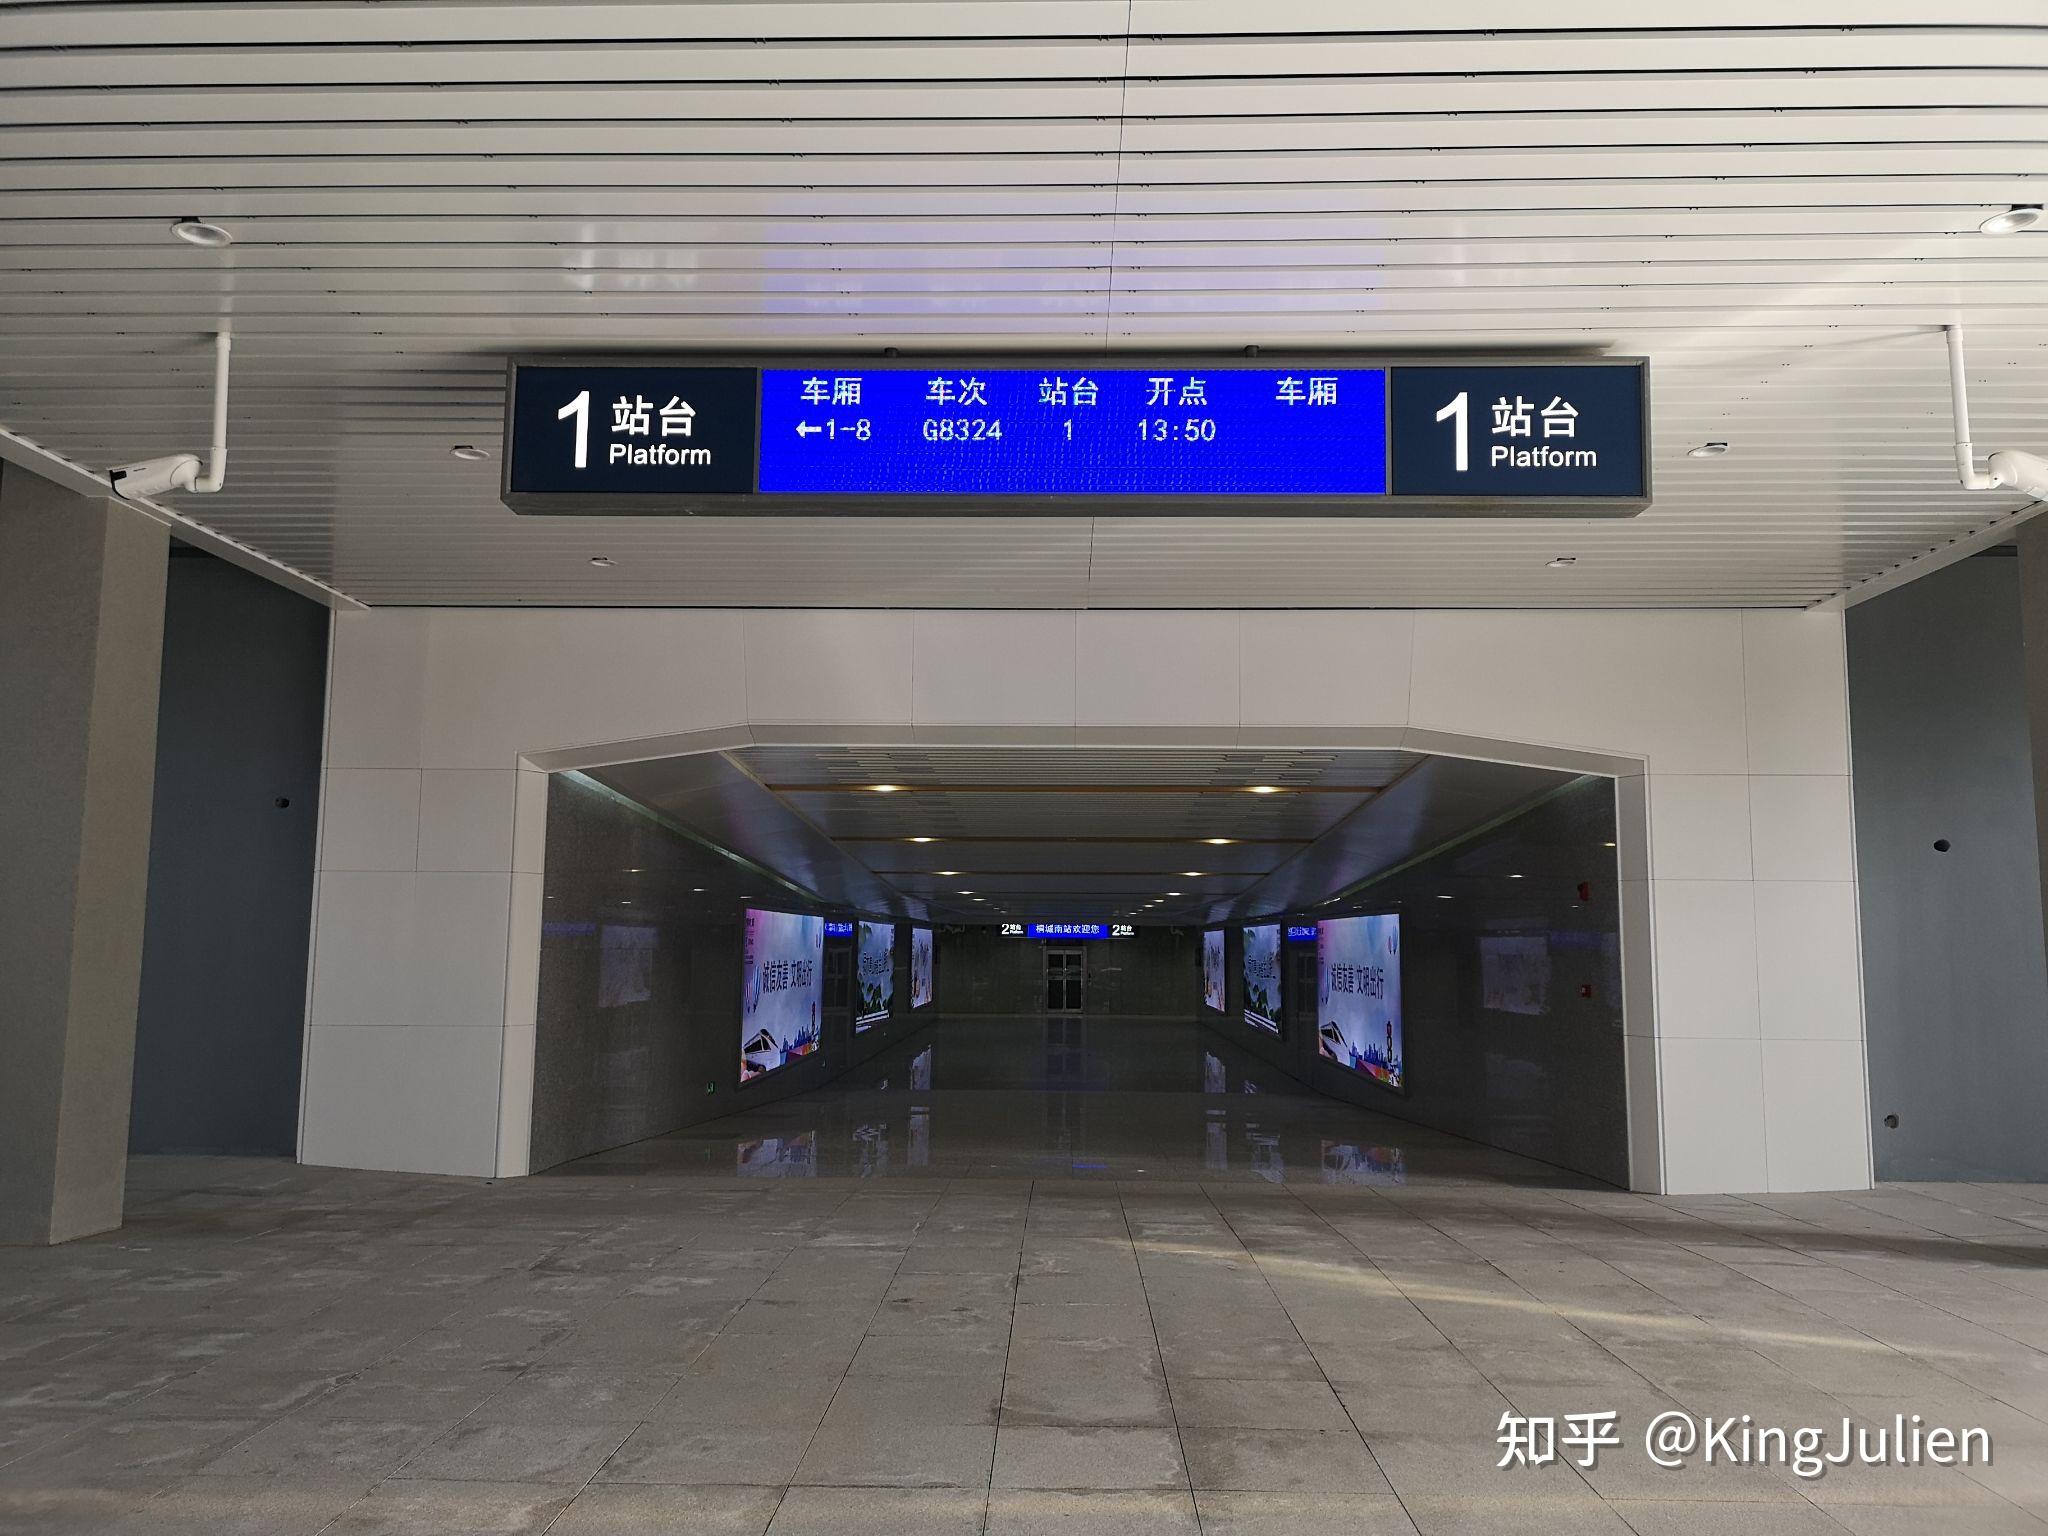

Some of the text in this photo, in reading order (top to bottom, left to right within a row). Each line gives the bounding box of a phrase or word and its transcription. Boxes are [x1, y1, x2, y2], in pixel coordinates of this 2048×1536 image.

[800, 376, 1339, 406] 车厢 车次 站台 开点 车厢
[557, 390, 696, 468] 1 站台
[826, 418, 1216, 442] 1-8 G8324 1 13:50
[1436, 391, 1579, 471] 1 站台
[609, 443, 711, 465] Platform
[1491, 445, 1597, 467] Platform
[1001, 923, 1010, 935] 2
[1035, 923, 1100, 935] 桐城南站欢迎您
[1111, 924, 1121, 936] 2
